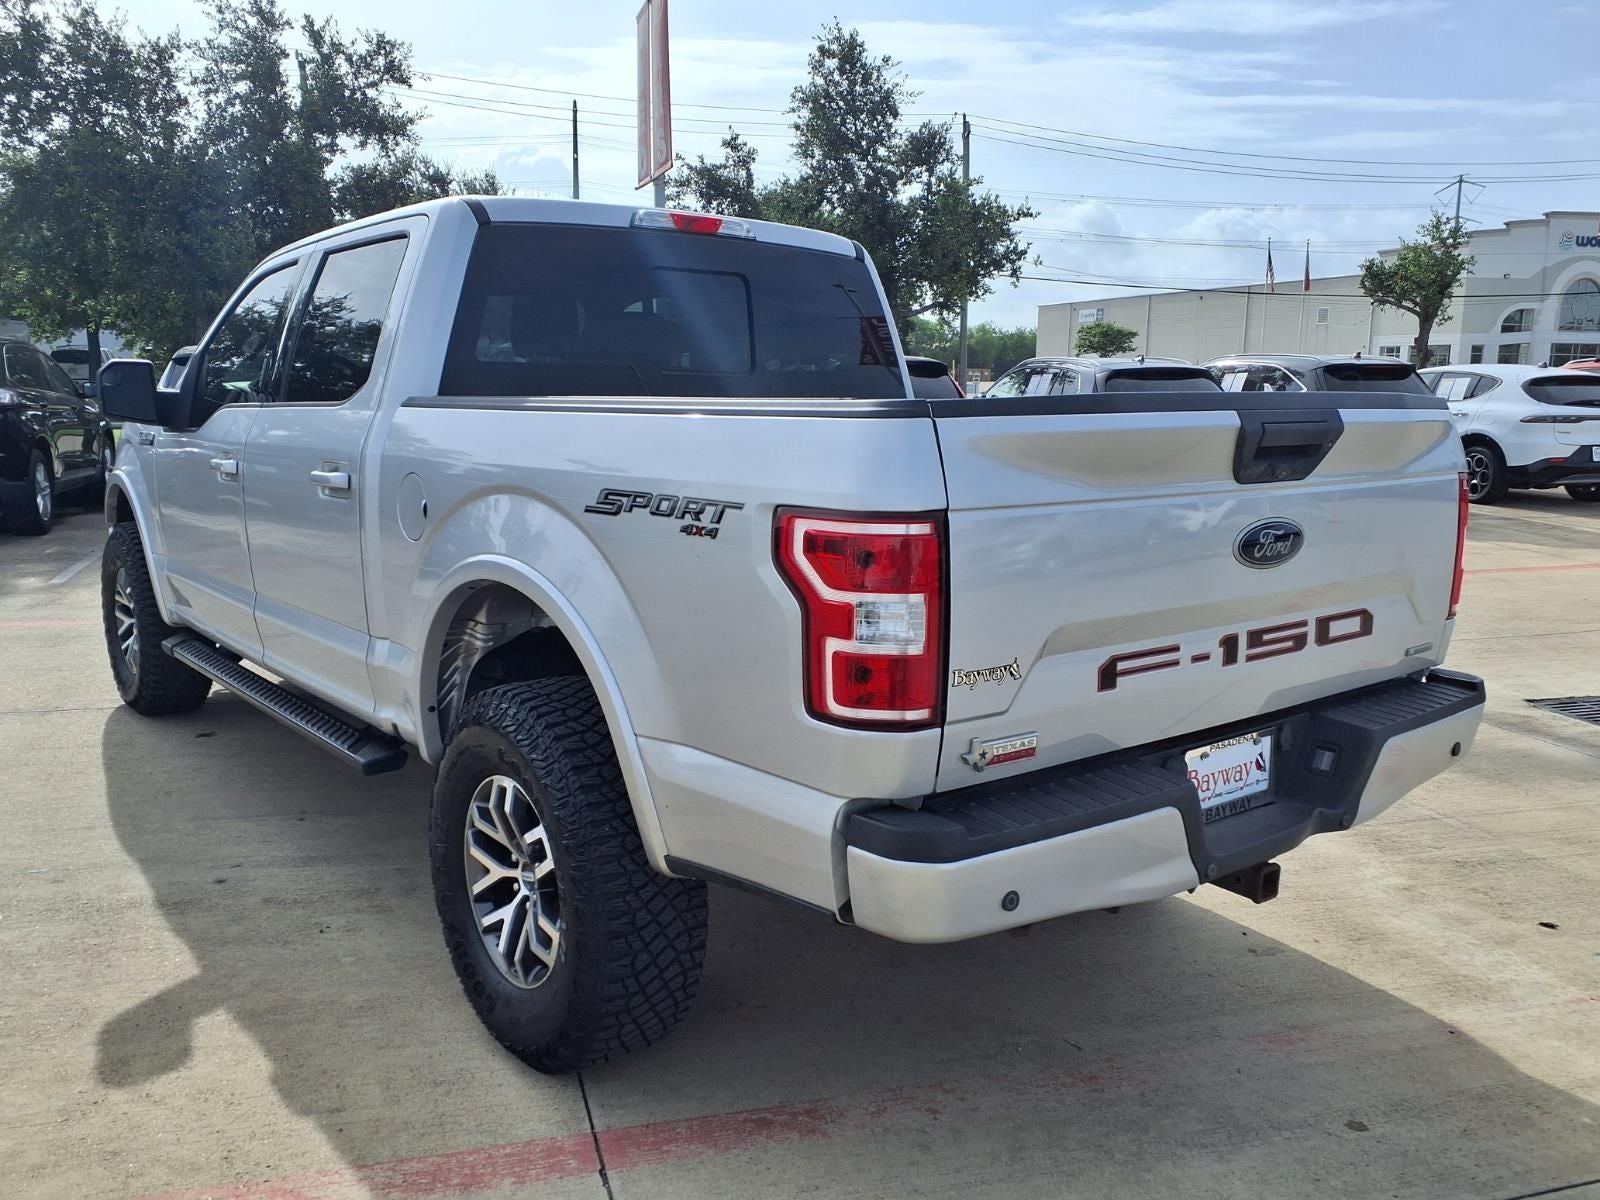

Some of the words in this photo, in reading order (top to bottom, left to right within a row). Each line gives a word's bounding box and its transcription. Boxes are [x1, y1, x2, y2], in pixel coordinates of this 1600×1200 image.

[583, 487, 747, 525] SPORT
[1254, 529, 1294, 558] Ford
[1097, 607, 1374, 693] F-150
[952, 662, 1011, 691] Bayway
[993, 738, 1036, 754] TEXAS
[1209, 733, 1255, 752] PASADENA
[1205, 797, 1253, 822] BAYWAY
